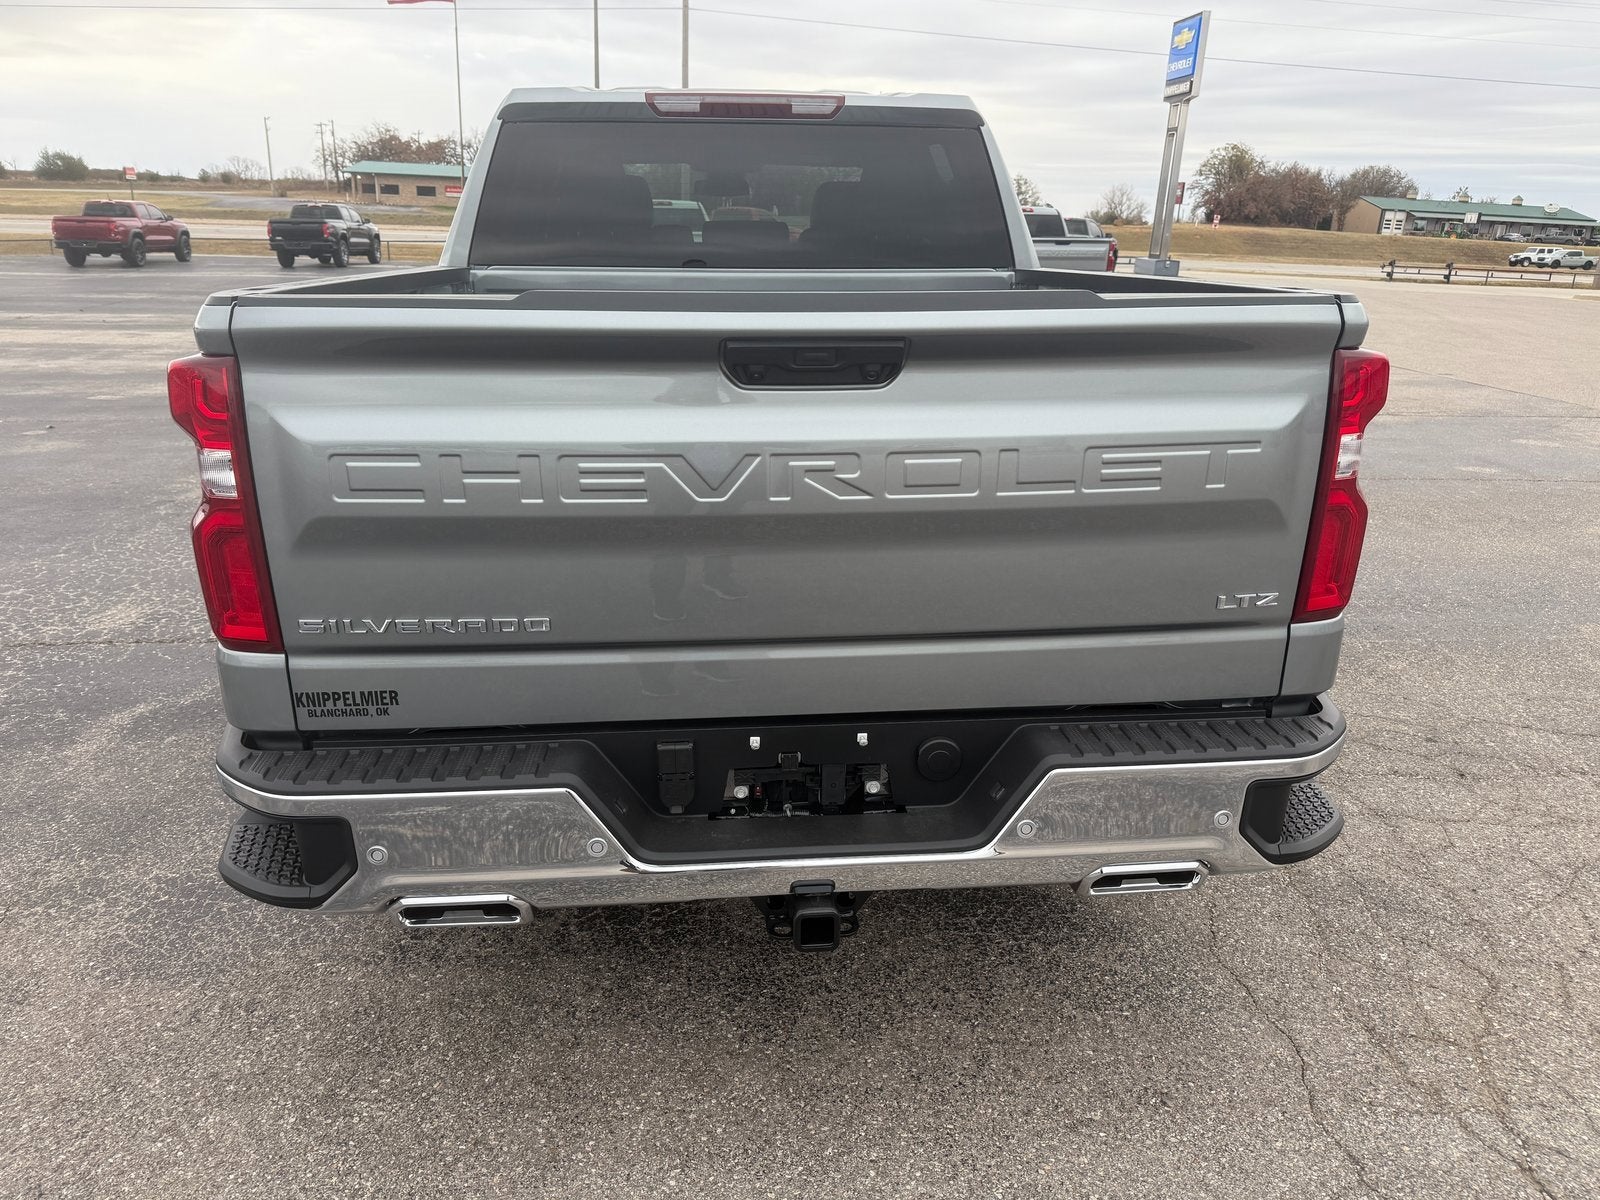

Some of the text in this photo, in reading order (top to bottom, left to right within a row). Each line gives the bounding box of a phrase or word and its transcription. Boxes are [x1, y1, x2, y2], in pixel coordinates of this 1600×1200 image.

[328, 440, 1262, 504] CHEVROLET
[1215, 592, 1279, 610] LTZ
[297, 616, 552, 635] SILVERADO
[294, 690, 400, 708] KNIPPELMIER
[375, 707, 391, 717] OK
